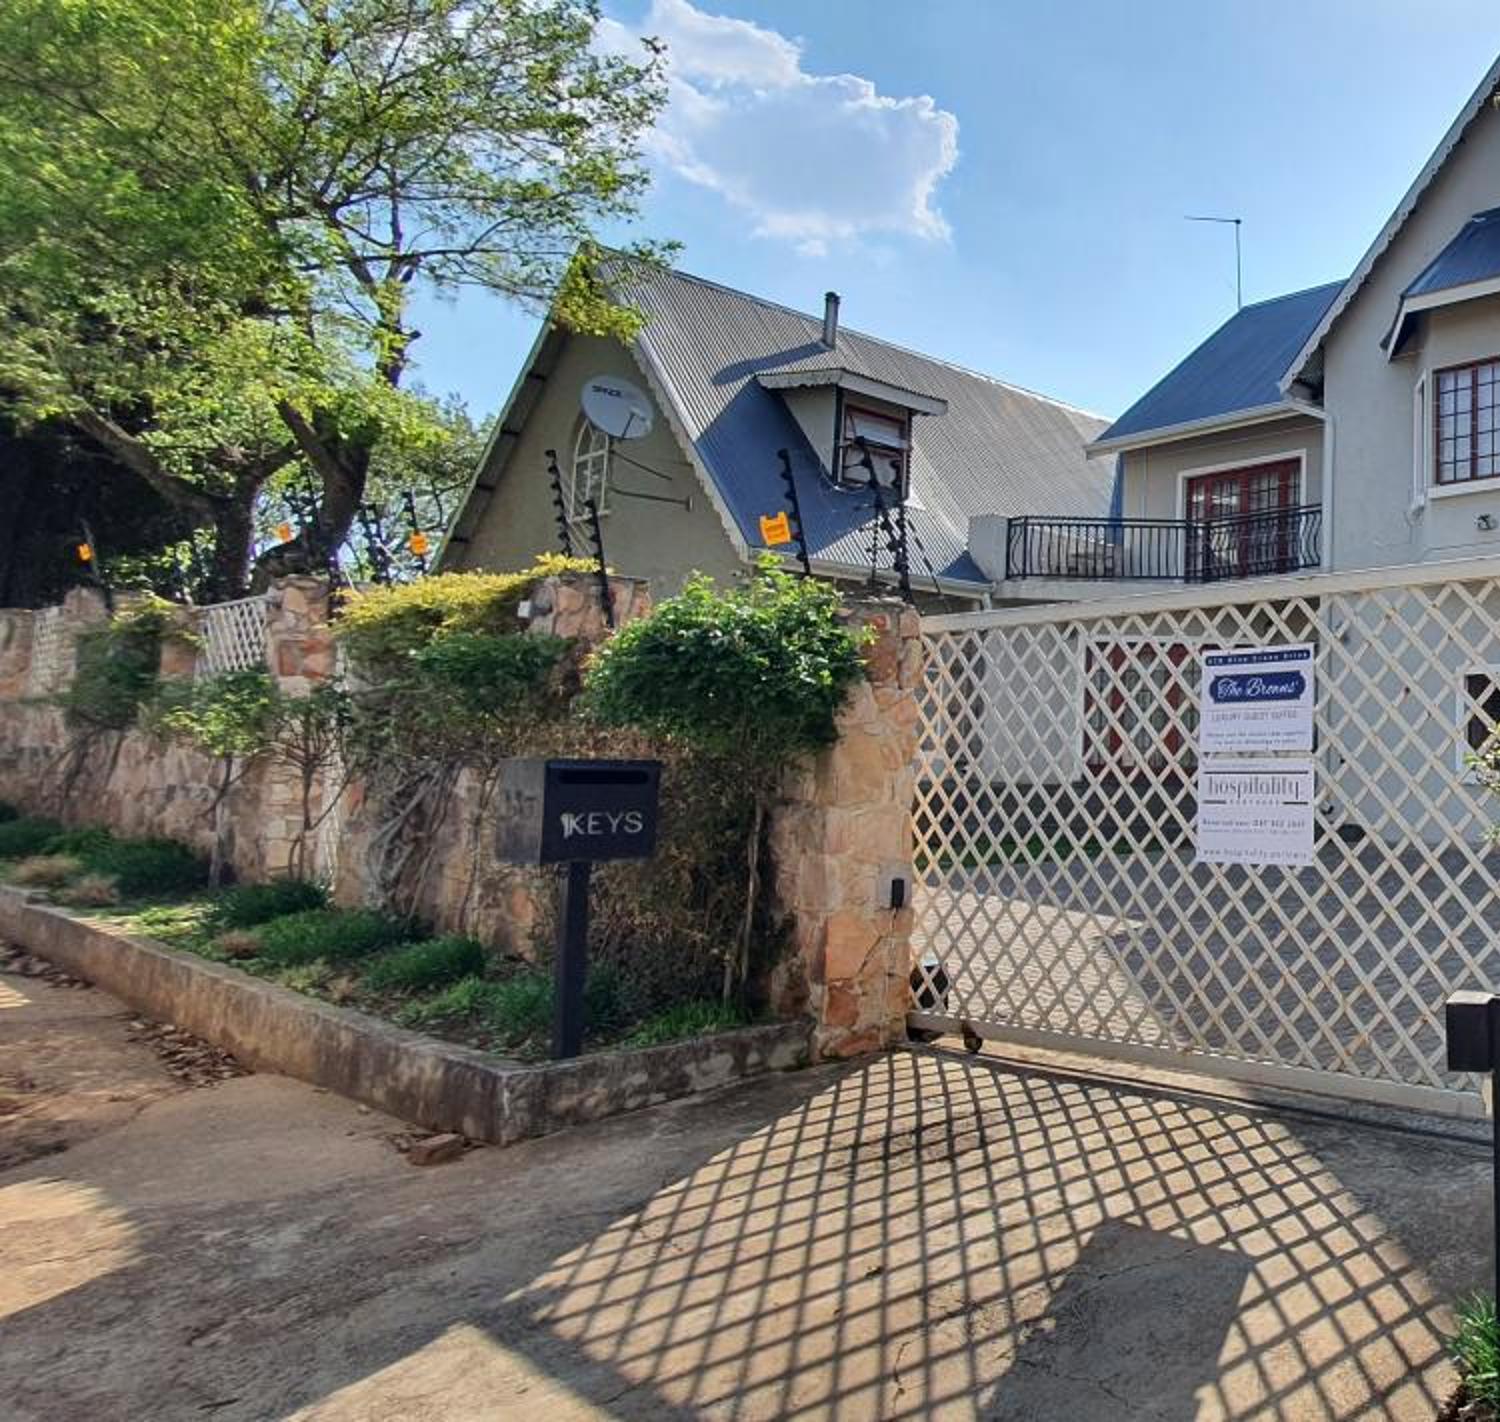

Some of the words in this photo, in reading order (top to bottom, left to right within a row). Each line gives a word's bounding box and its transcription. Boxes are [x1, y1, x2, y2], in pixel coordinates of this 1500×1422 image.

[1217, 678, 1243, 699] The
[1208, 775, 1300, 800] hospitality
[568, 811, 644, 836] KEYS
